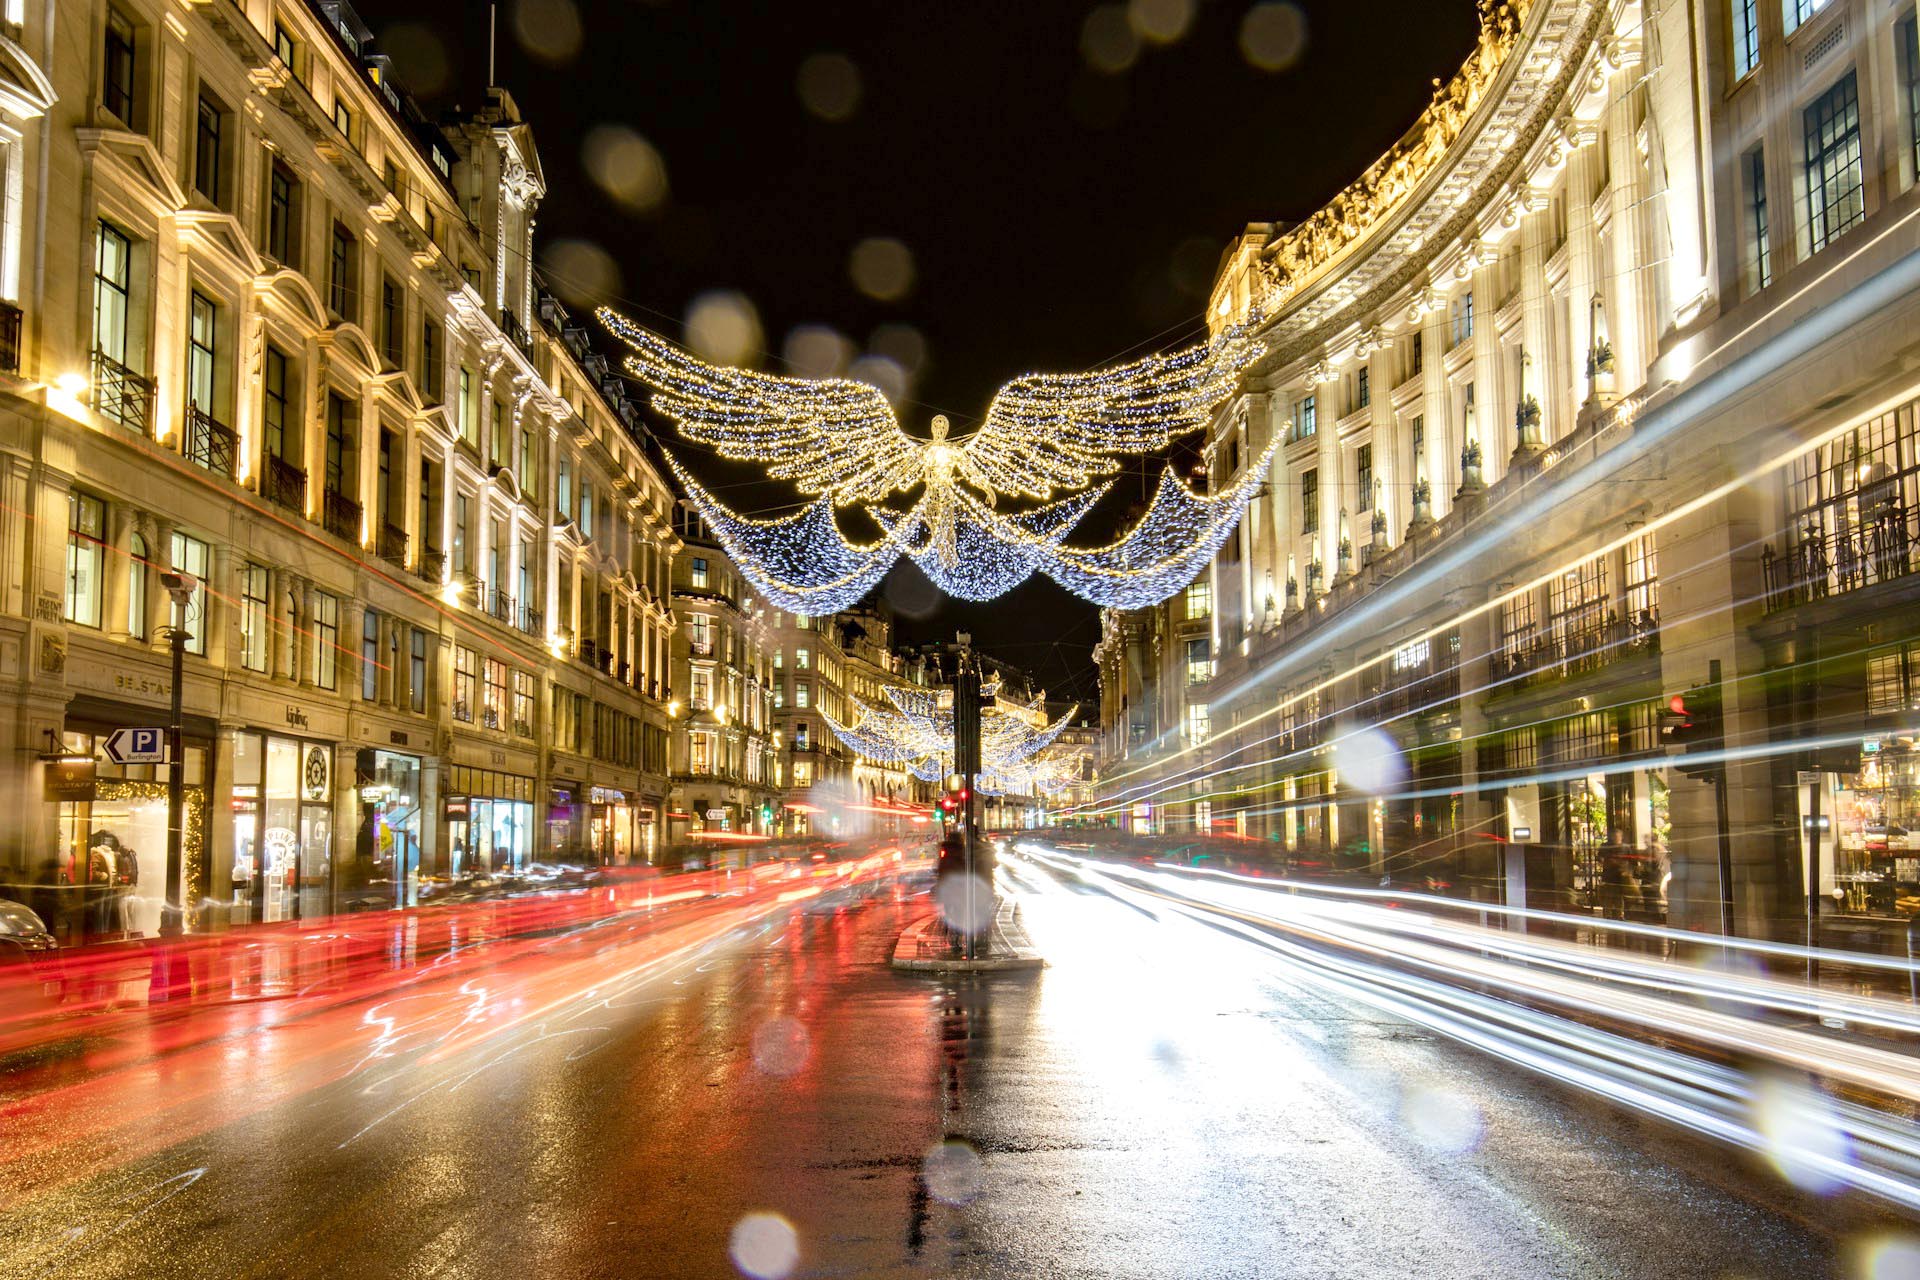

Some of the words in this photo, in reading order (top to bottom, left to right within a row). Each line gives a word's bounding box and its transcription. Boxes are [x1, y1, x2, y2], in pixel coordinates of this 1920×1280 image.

[114, 675, 172, 696] BELSTAF
[286, 704, 309, 731] kipling
[136, 731, 153, 751] P
